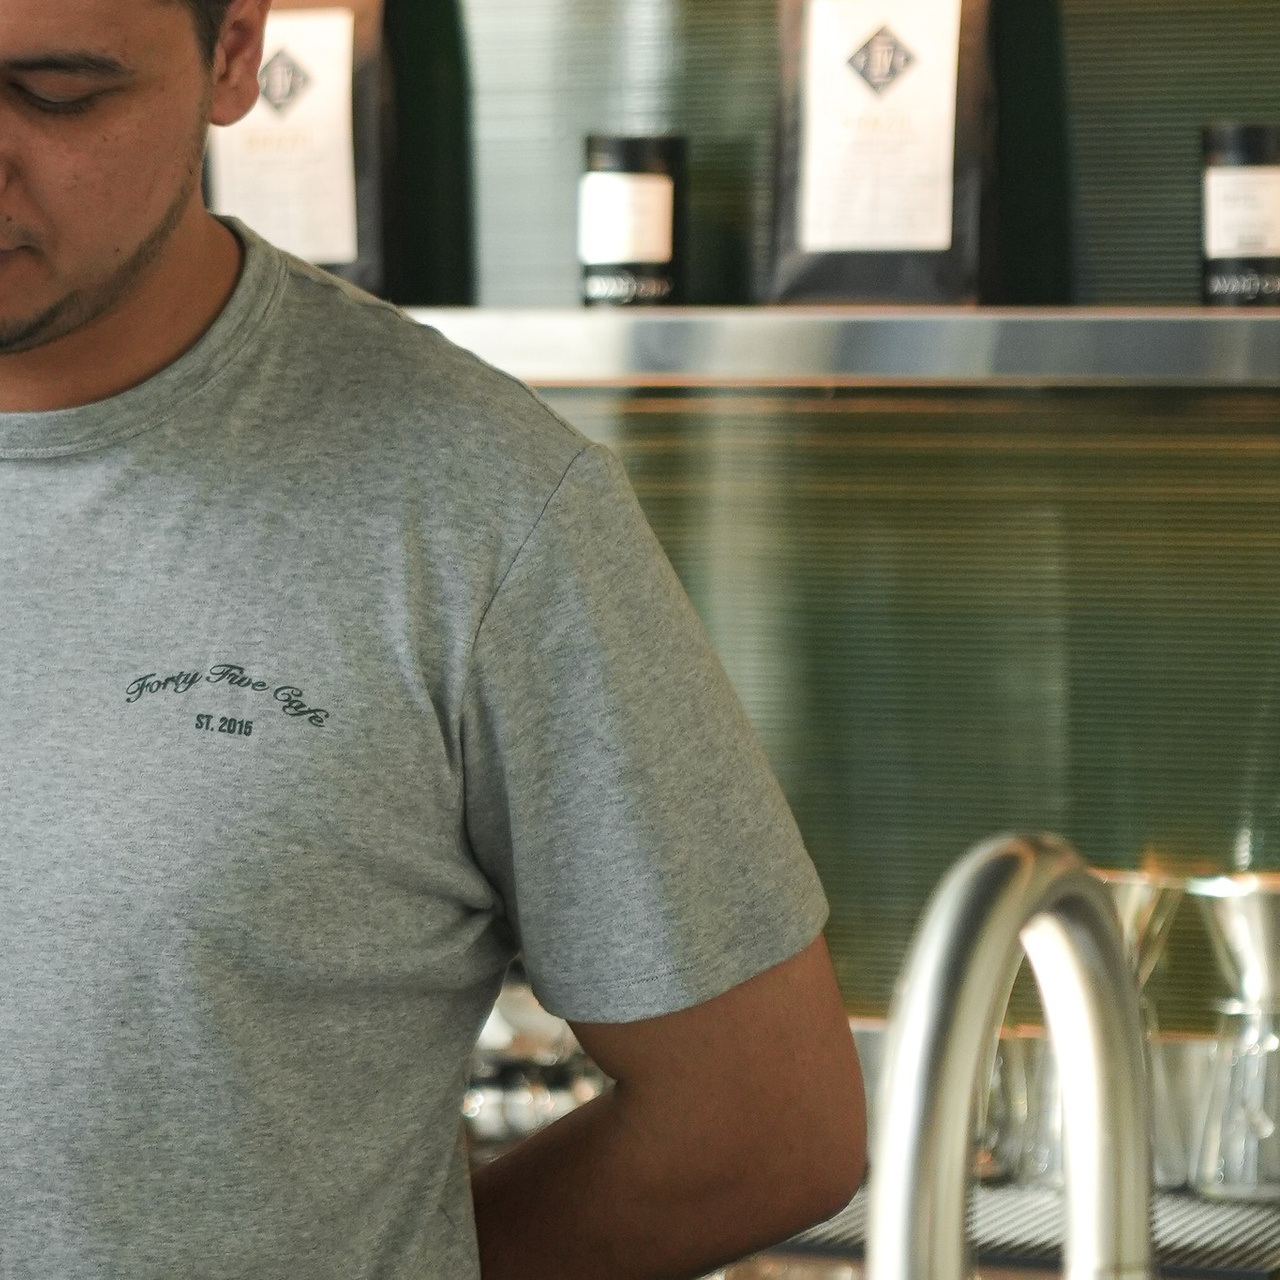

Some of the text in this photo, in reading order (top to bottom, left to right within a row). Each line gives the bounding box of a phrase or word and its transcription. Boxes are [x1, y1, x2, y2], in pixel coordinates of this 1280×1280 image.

[125, 669, 203, 704] Forty
[205, 663, 270, 692] Five
[195, 713, 215, 733] ST.
